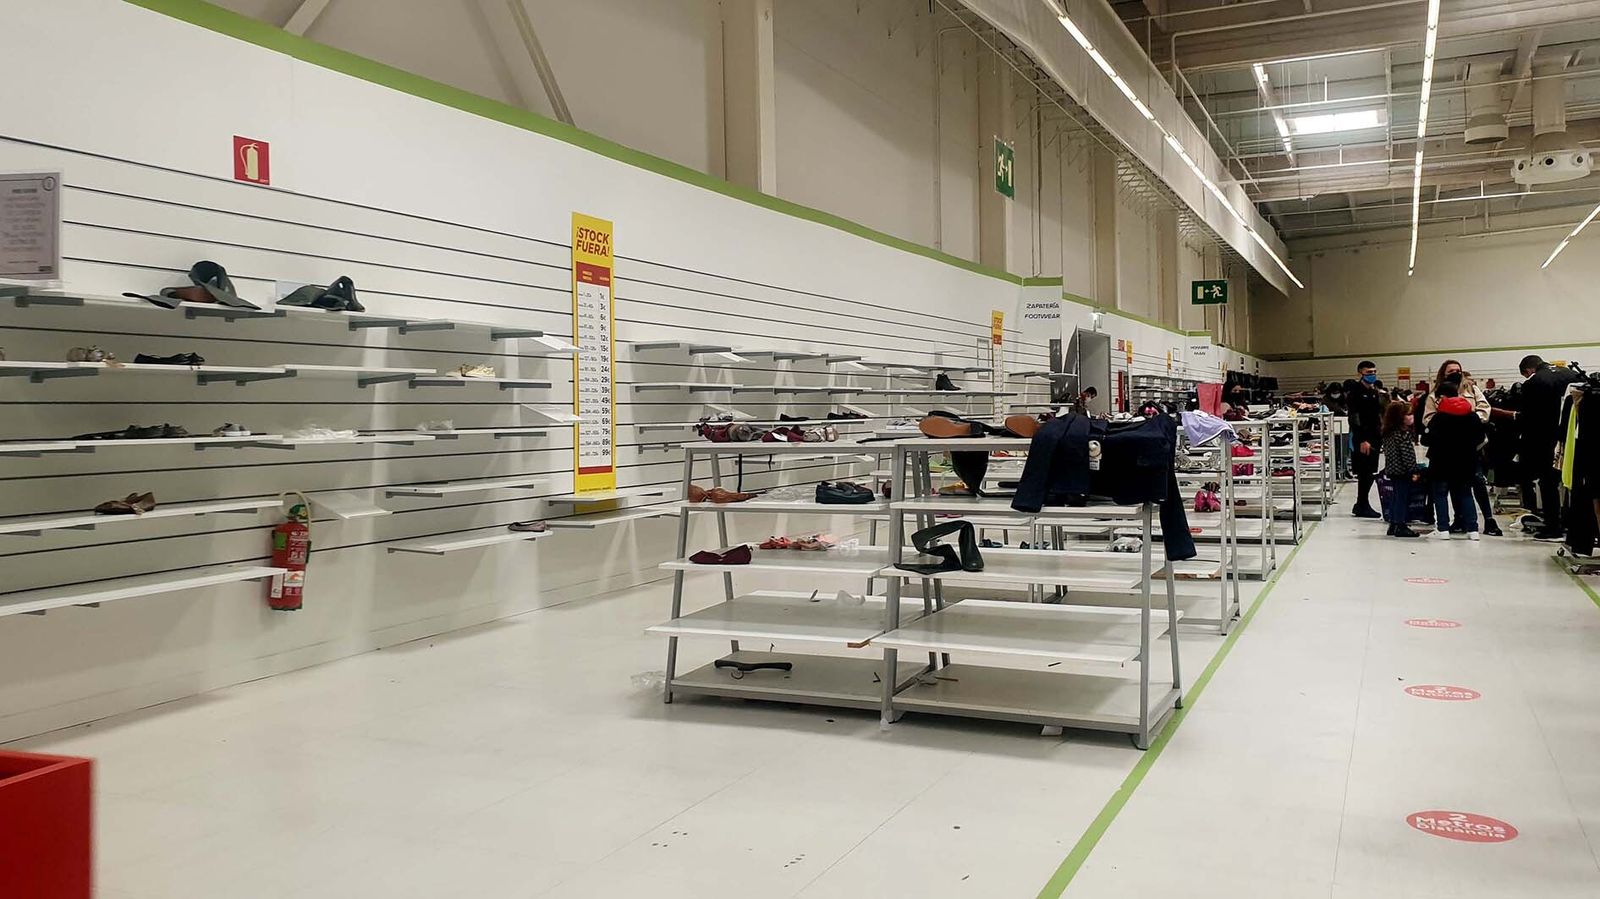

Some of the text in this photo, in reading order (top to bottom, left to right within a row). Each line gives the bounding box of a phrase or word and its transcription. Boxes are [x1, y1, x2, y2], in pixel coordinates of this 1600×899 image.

[576, 226, 610, 245] ¡STOCK
[576, 239, 610, 257] FUERA!
[1415, 816, 1506, 834] Metros
[1448, 813, 1468, 822] 2
[1416, 824, 1505, 838] Distancia
